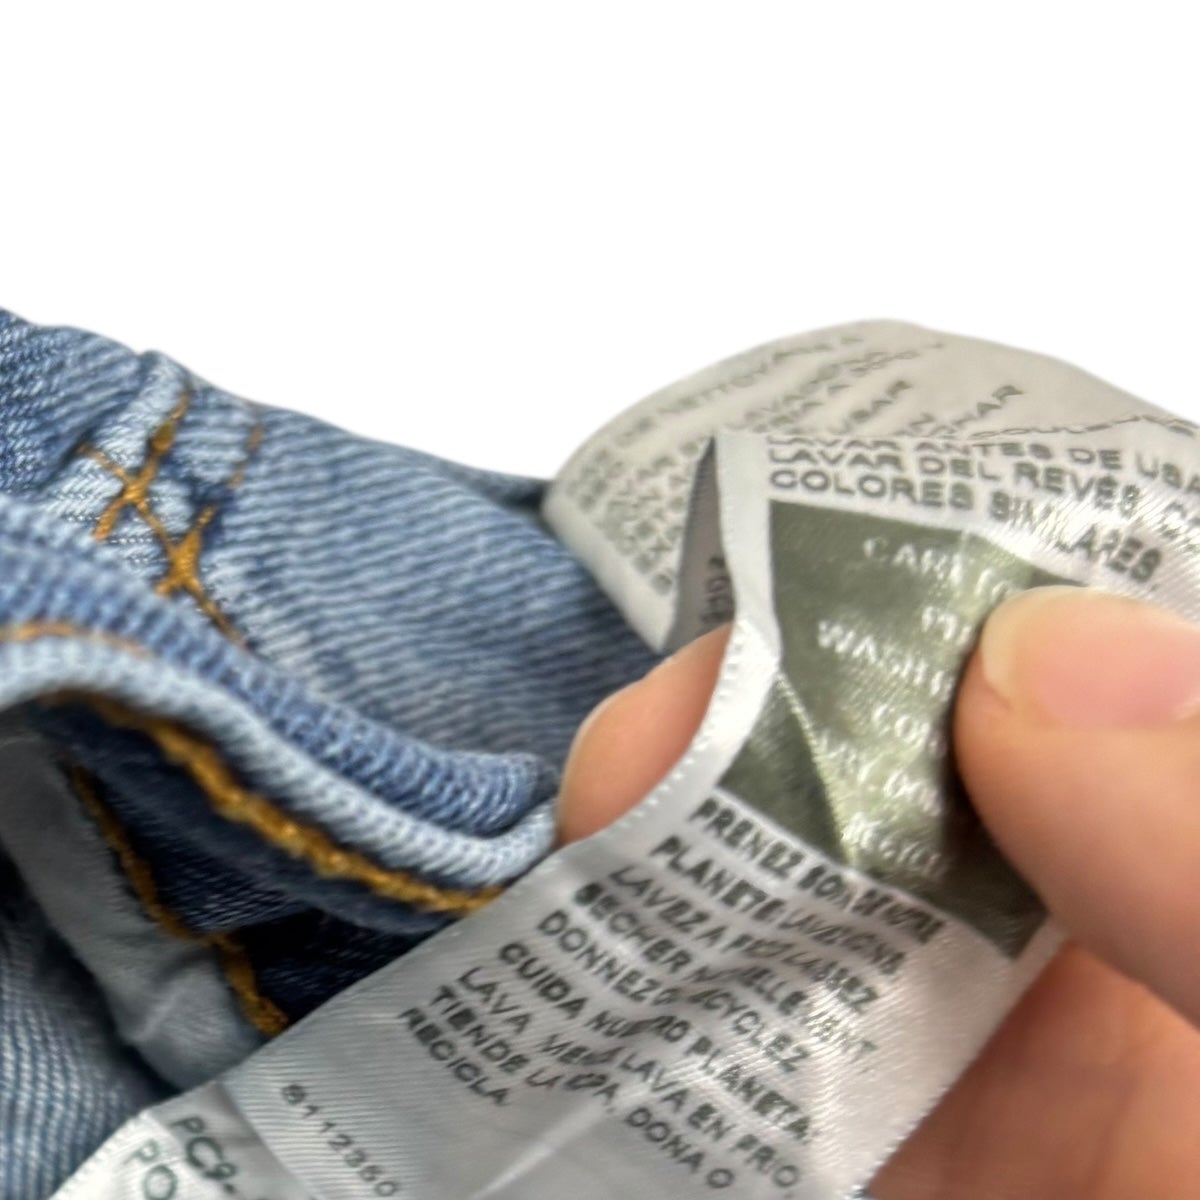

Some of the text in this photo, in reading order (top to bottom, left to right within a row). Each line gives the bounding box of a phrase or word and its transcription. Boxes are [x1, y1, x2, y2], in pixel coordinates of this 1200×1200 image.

[767, 449, 905, 474] LAVAR
[918, 455, 1001, 481] DEL
[768, 469, 975, 510] COLORES
[1068, 447, 1123, 470] DE
[688, 798, 805, 880] PRENEZ
[609, 865, 710, 934] LAVEZ
[499, 942, 588, 1020] CUIDA
[537, 909, 661, 1003] DONNEZ
[429, 984, 531, 1075] TIENDE
[624, 1106, 706, 1174] DONA
[705, 1167, 736, 1189] O
[458, 966, 532, 1036] LAVA
[618, 1053, 690, 1114] LAVA
[687, 1103, 737, 1142] EN
